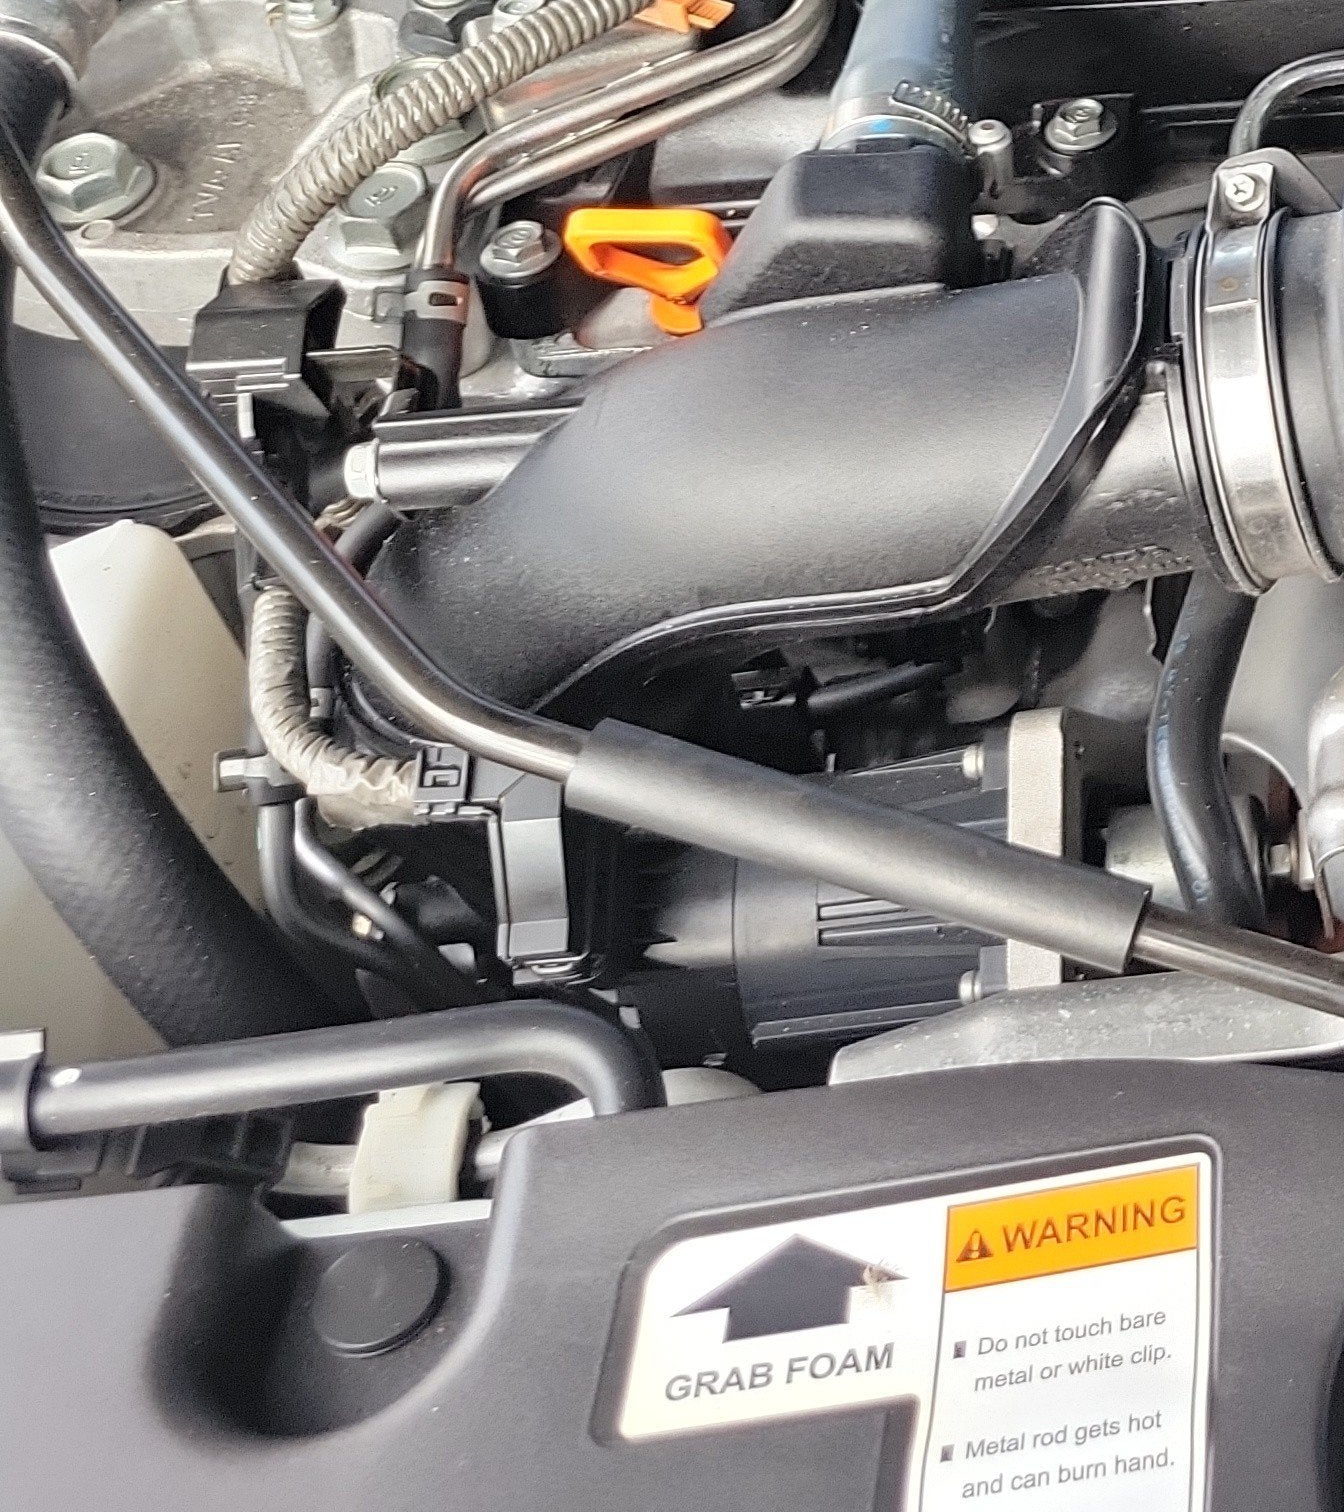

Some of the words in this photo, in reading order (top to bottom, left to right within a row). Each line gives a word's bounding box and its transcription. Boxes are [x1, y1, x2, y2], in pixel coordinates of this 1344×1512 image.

[1002, 1194, 1188, 1254] WARNING
[978, 1337, 1008, 1355] Do
[1015, 1327, 1048, 1349] not
[1054, 1316, 1112, 1343] touch
[1119, 1311, 1166, 1331] bare
[664, 1361, 774, 1402] GRAB
[785, 1342, 895, 1384] FOAM
[974, 1364, 1033, 1391] metal
[1040, 1363, 1062, 1380] or
[1068, 1352, 1124, 1375] white
[1131, 1343, 1172, 1365] clip.
[965, 1432, 1025, 1459] Metal
[1032, 1424, 1068, 1448] rod
[1074, 1418, 1121, 1446] gets
[1128, 1410, 1162, 1433] hot
[961, 1473, 1003, 1499] and
[1011, 1469, 1050, 1491] can
[1058, 1460, 1107, 1484] burn
[1115, 1447, 1175, 1475] hand.
